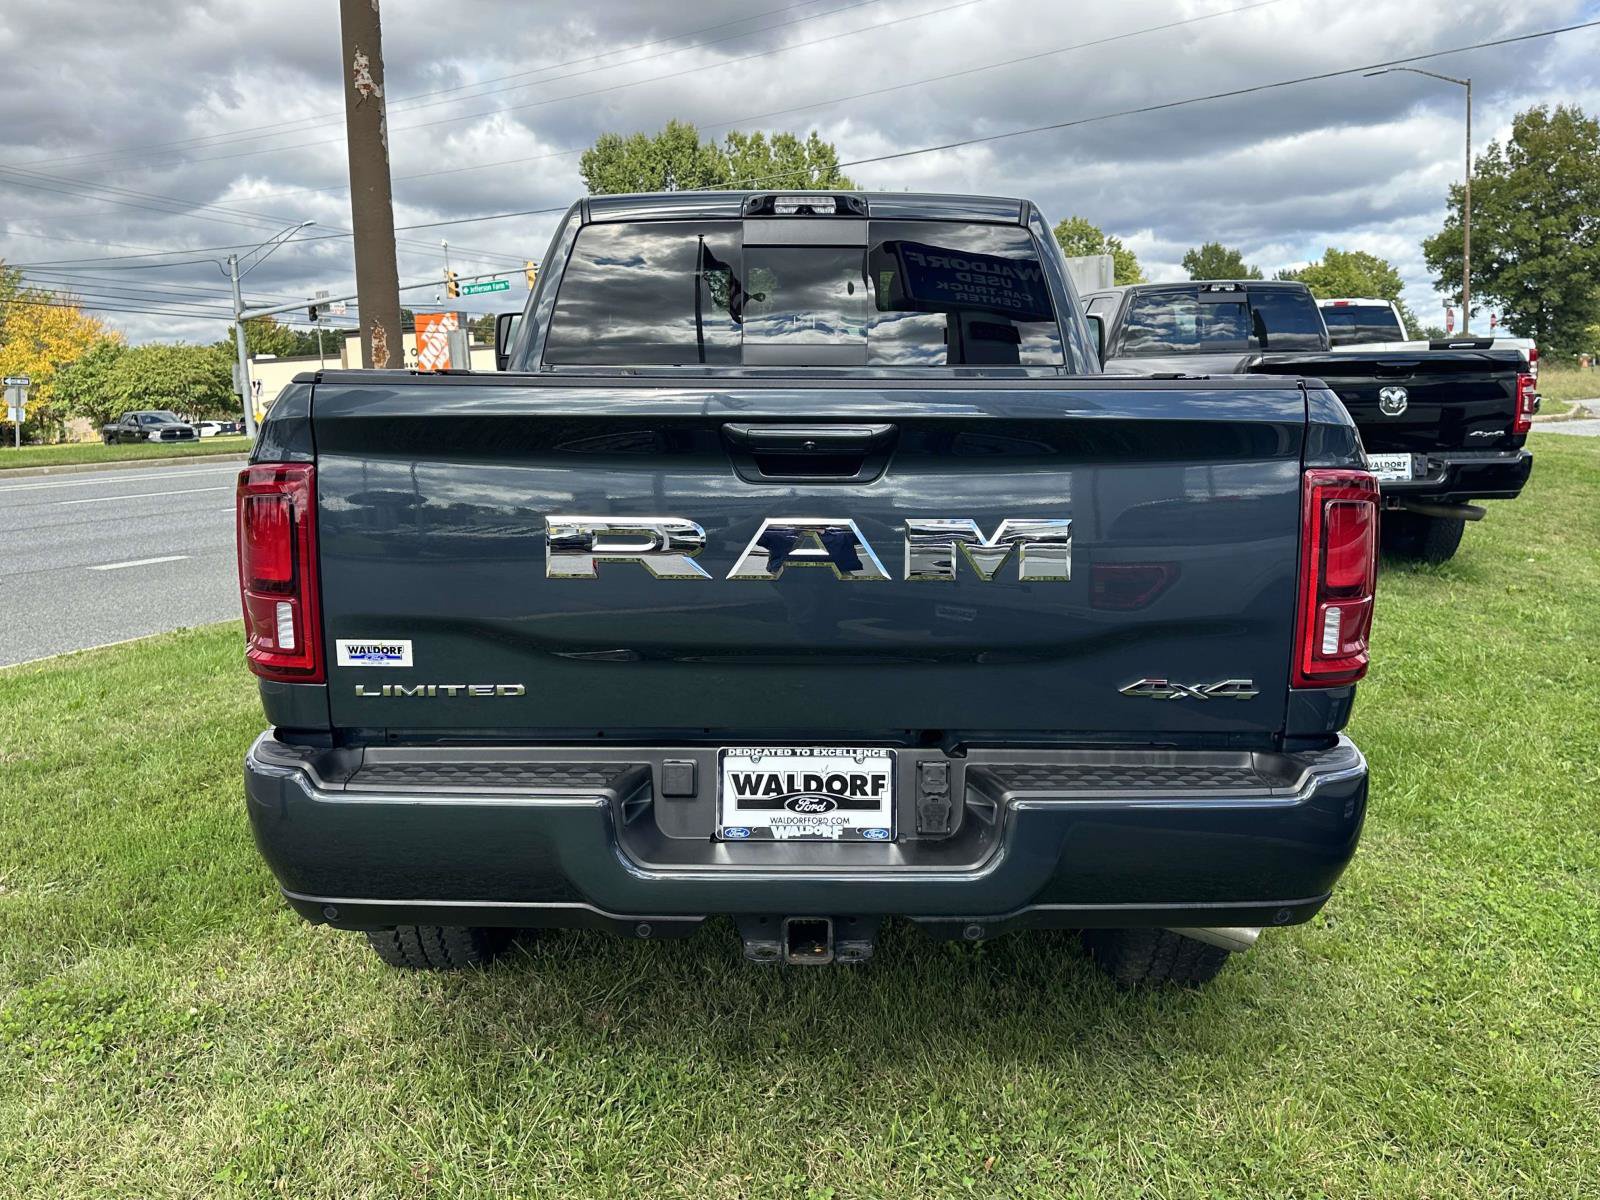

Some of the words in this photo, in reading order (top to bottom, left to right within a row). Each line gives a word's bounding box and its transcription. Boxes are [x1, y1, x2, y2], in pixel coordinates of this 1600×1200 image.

[545, 515, 1073, 581] RAM
[347, 646, 403, 655] WALDORF
[355, 684, 526, 697] LIMITED
[727, 749, 792, 757] DEDICATED
[796, 749, 810, 757] TO
[813, 749, 888, 758] EXCELLENCE
[731, 773, 886, 797] WALDORF
[795, 798, 827, 812] Ford
[769, 816, 851, 826] WALDORFFORD.COM
[769, 823, 845, 840] WALDORF
